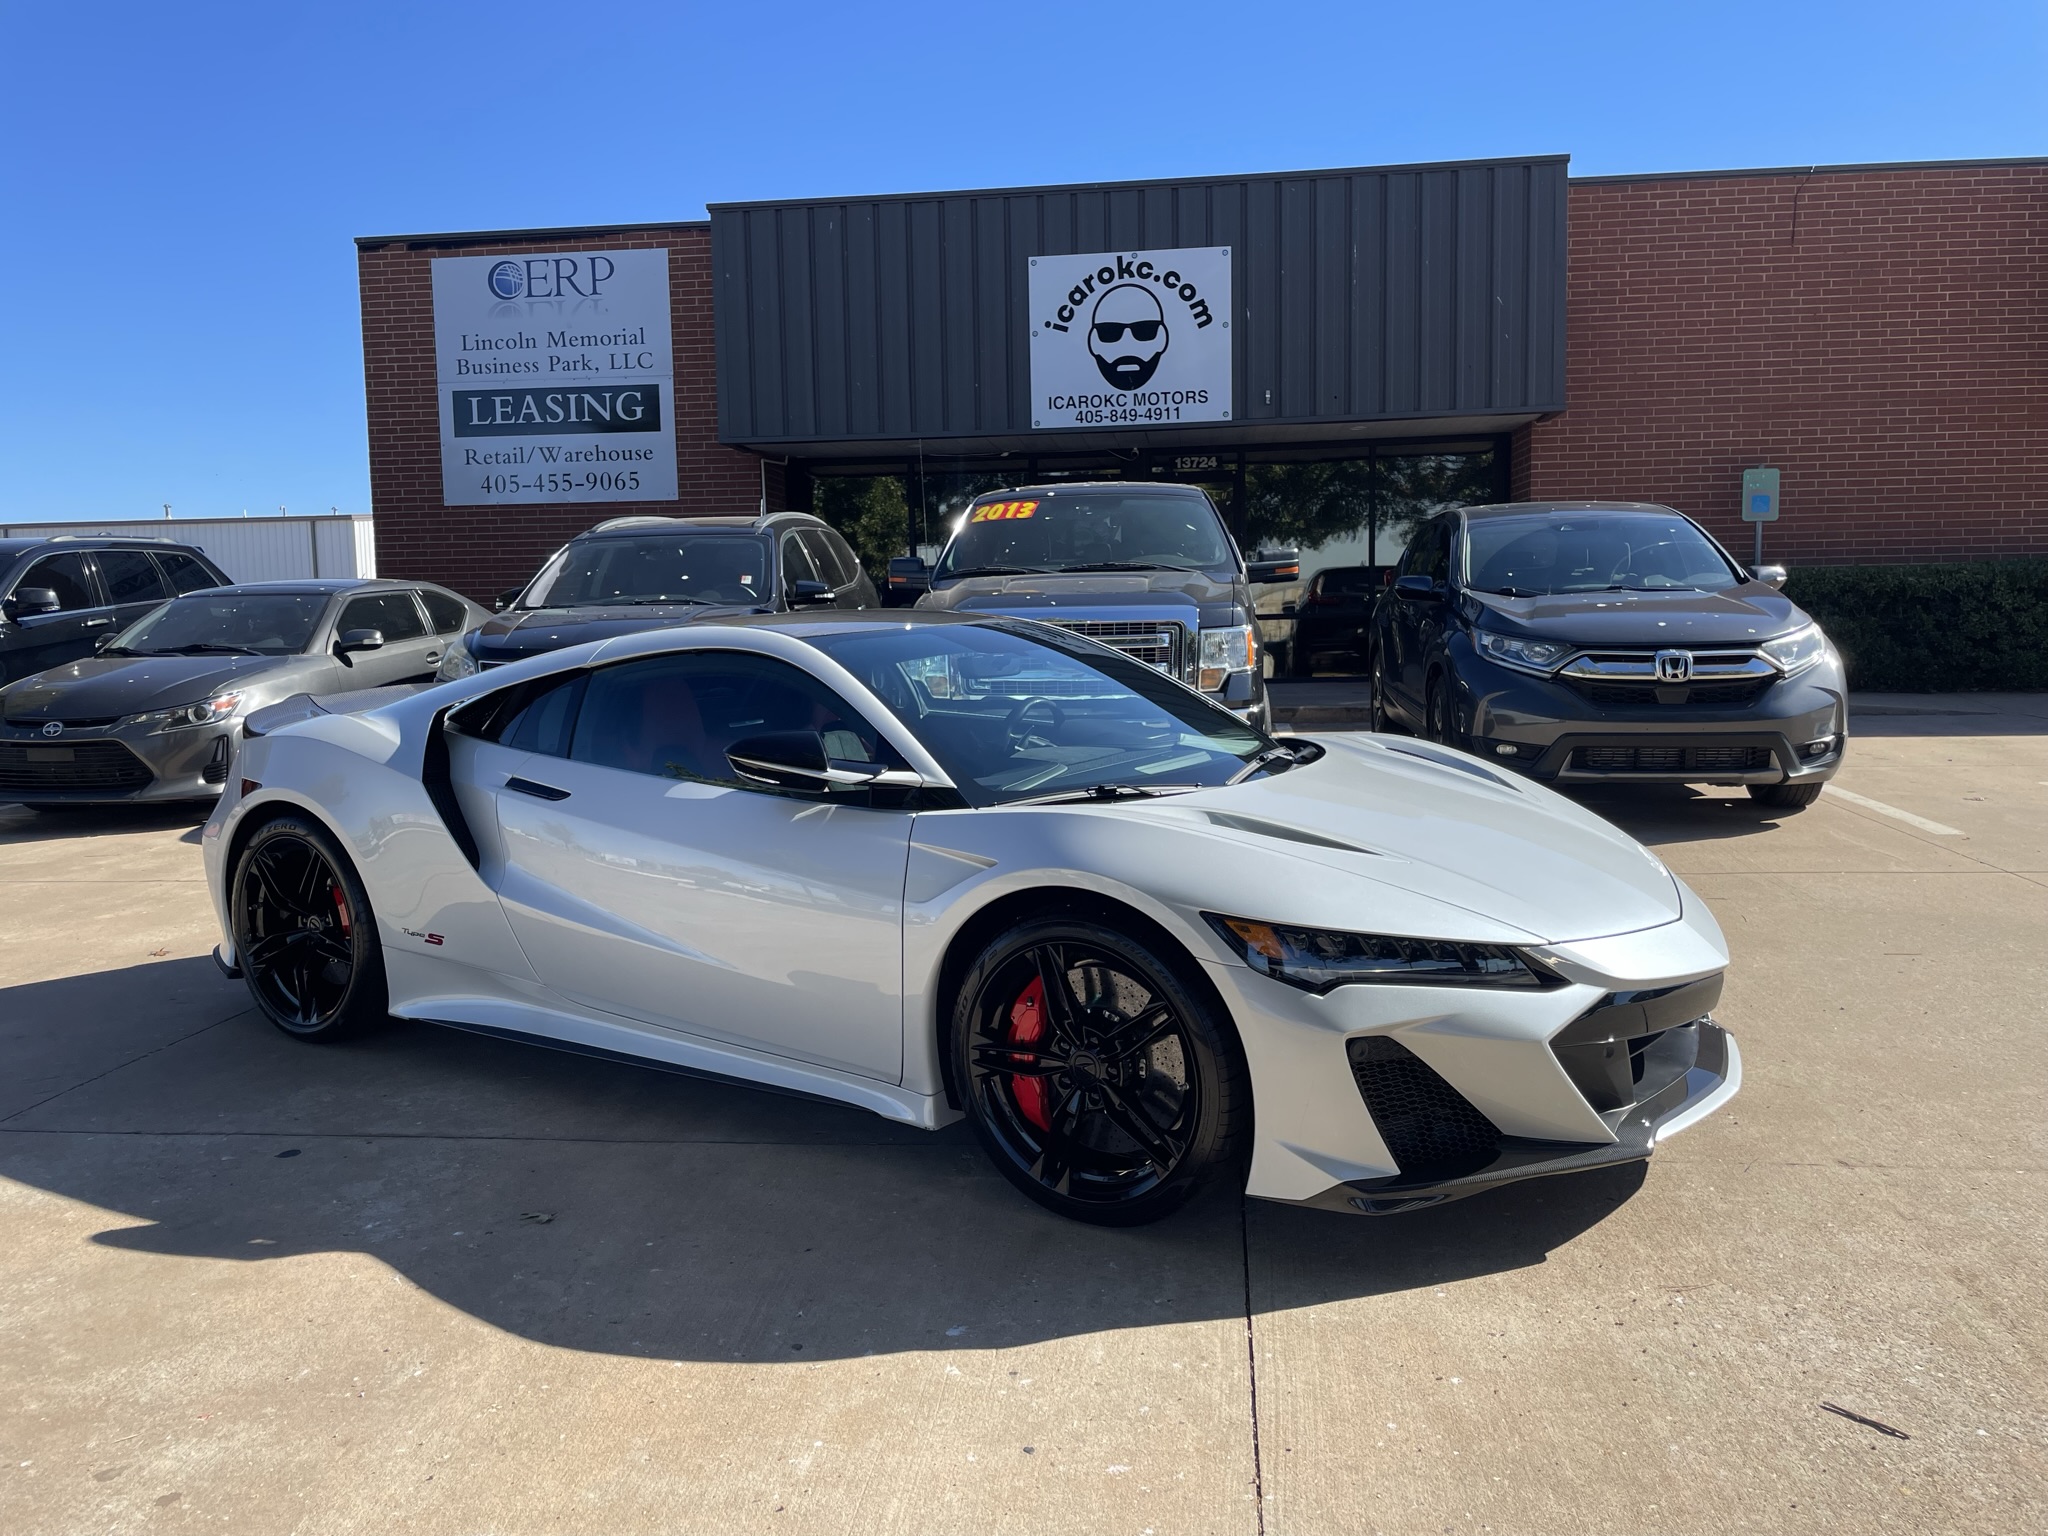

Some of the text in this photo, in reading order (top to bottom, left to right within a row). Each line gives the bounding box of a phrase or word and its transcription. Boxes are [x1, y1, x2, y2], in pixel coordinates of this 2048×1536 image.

[1044, 255, 1213, 333] icarokc.com
[461, 328, 646, 351] Lincoln Memorial
[456, 352, 654, 375] Business Park, LLC
[468, 392, 644, 425] LEASING
[1049, 390, 1209, 410] ICAROKC MOTORS
[1075, 406, 1181, 424] 405-849-4911
[464, 445, 654, 466] Retail/Warehouse
[1174, 456, 1218, 468] 13724
[481, 471, 640, 494] 405-455-9065
[971, 502, 1037, 523] 2013
[424, 933, 445, 946] S
